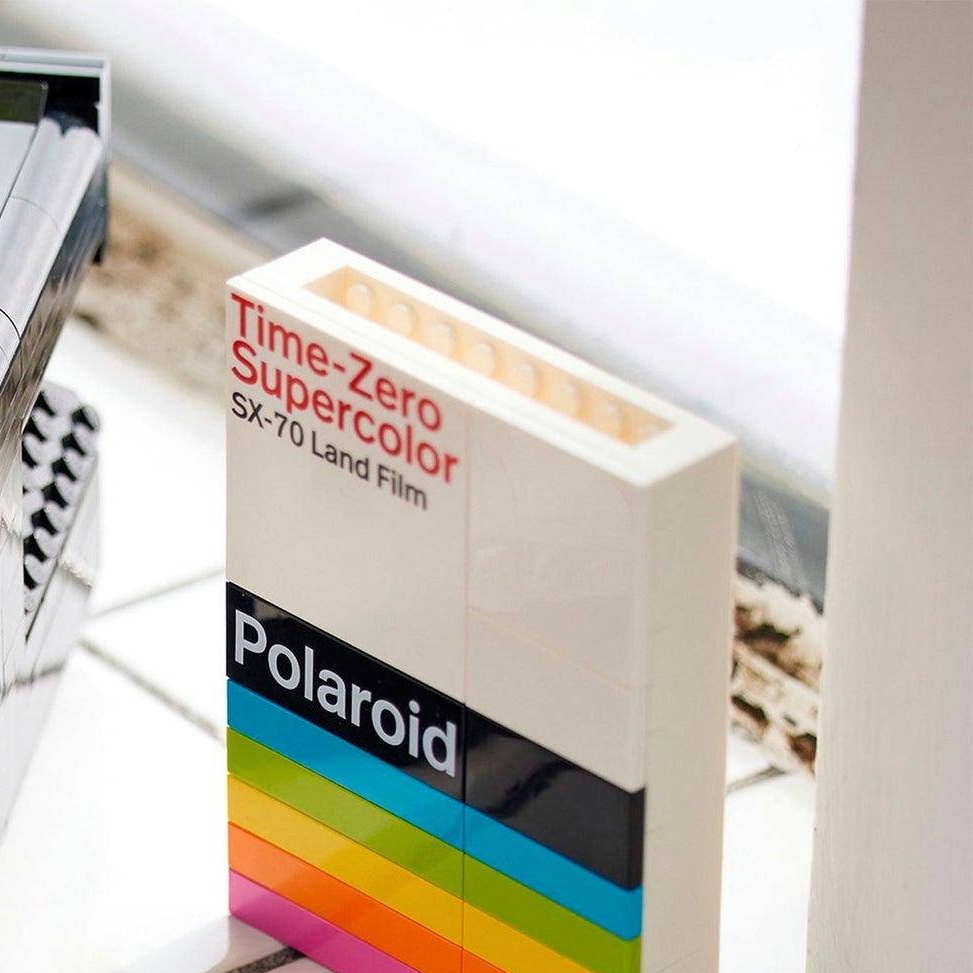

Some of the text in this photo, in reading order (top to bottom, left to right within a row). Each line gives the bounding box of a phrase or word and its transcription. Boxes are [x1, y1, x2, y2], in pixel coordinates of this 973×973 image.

[231, 293, 442, 432] Time-Zero
[231, 340, 458, 484] Supercolor
[231, 391, 427, 511] SX-70 Land Film
[234, 608, 457, 778] Polaroid
